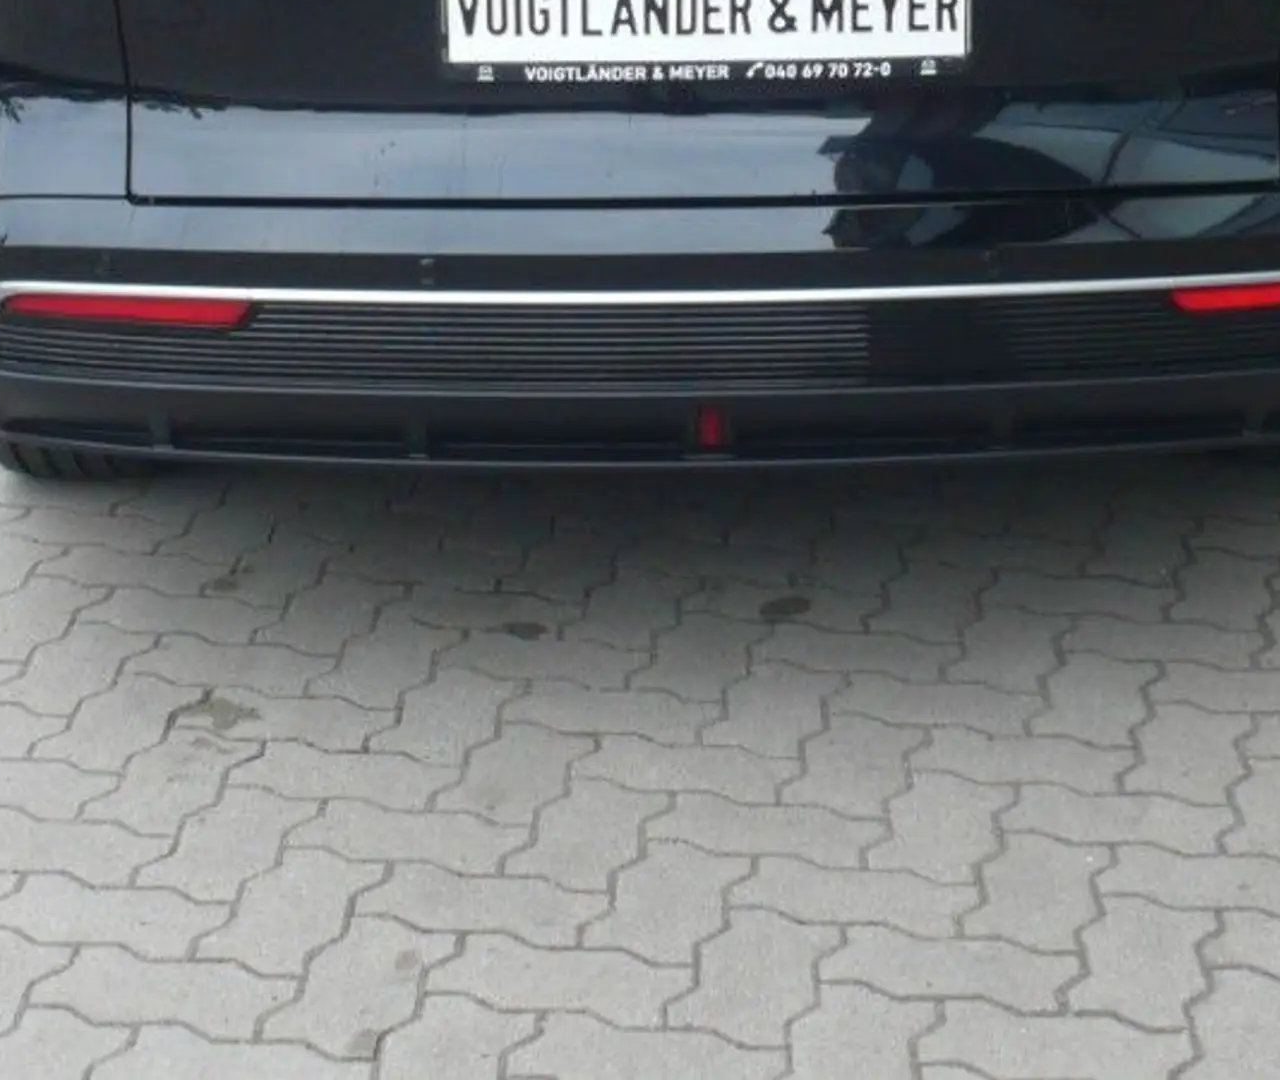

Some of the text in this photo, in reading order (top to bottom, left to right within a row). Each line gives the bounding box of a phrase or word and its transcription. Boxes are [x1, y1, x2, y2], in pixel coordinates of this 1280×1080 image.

[524, 61, 891, 82] VOIGTLÄNDER & MEYER 040 69 70 72-0
